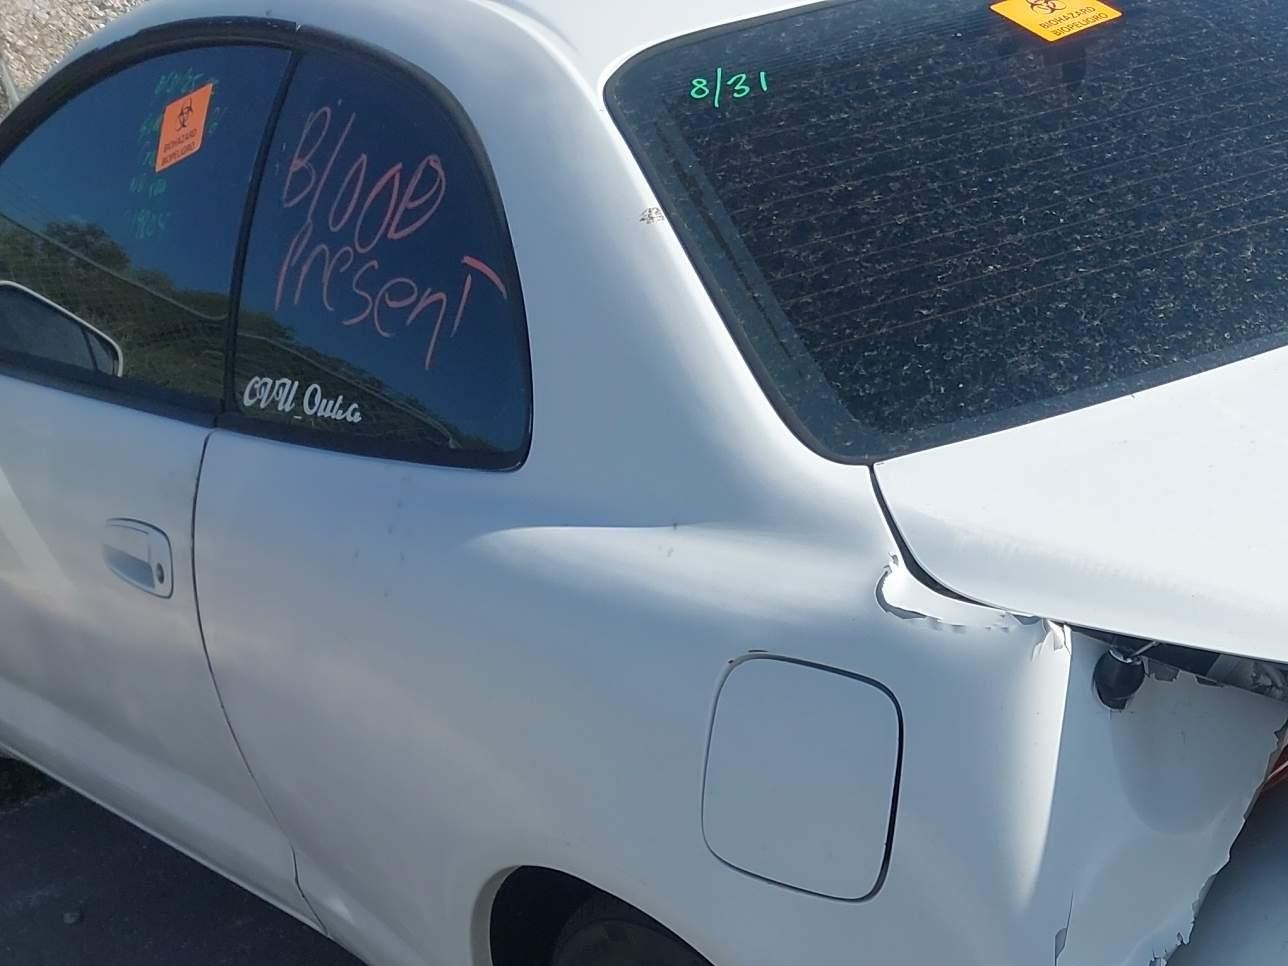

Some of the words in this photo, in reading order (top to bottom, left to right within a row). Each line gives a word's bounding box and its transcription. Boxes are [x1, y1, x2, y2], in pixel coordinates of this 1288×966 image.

[1038, 6, 1096, 29] BIOHAZARD
[1050, 12, 1109, 37] BIOPELIGRO
[689, 66, 768, 109] 8/31
